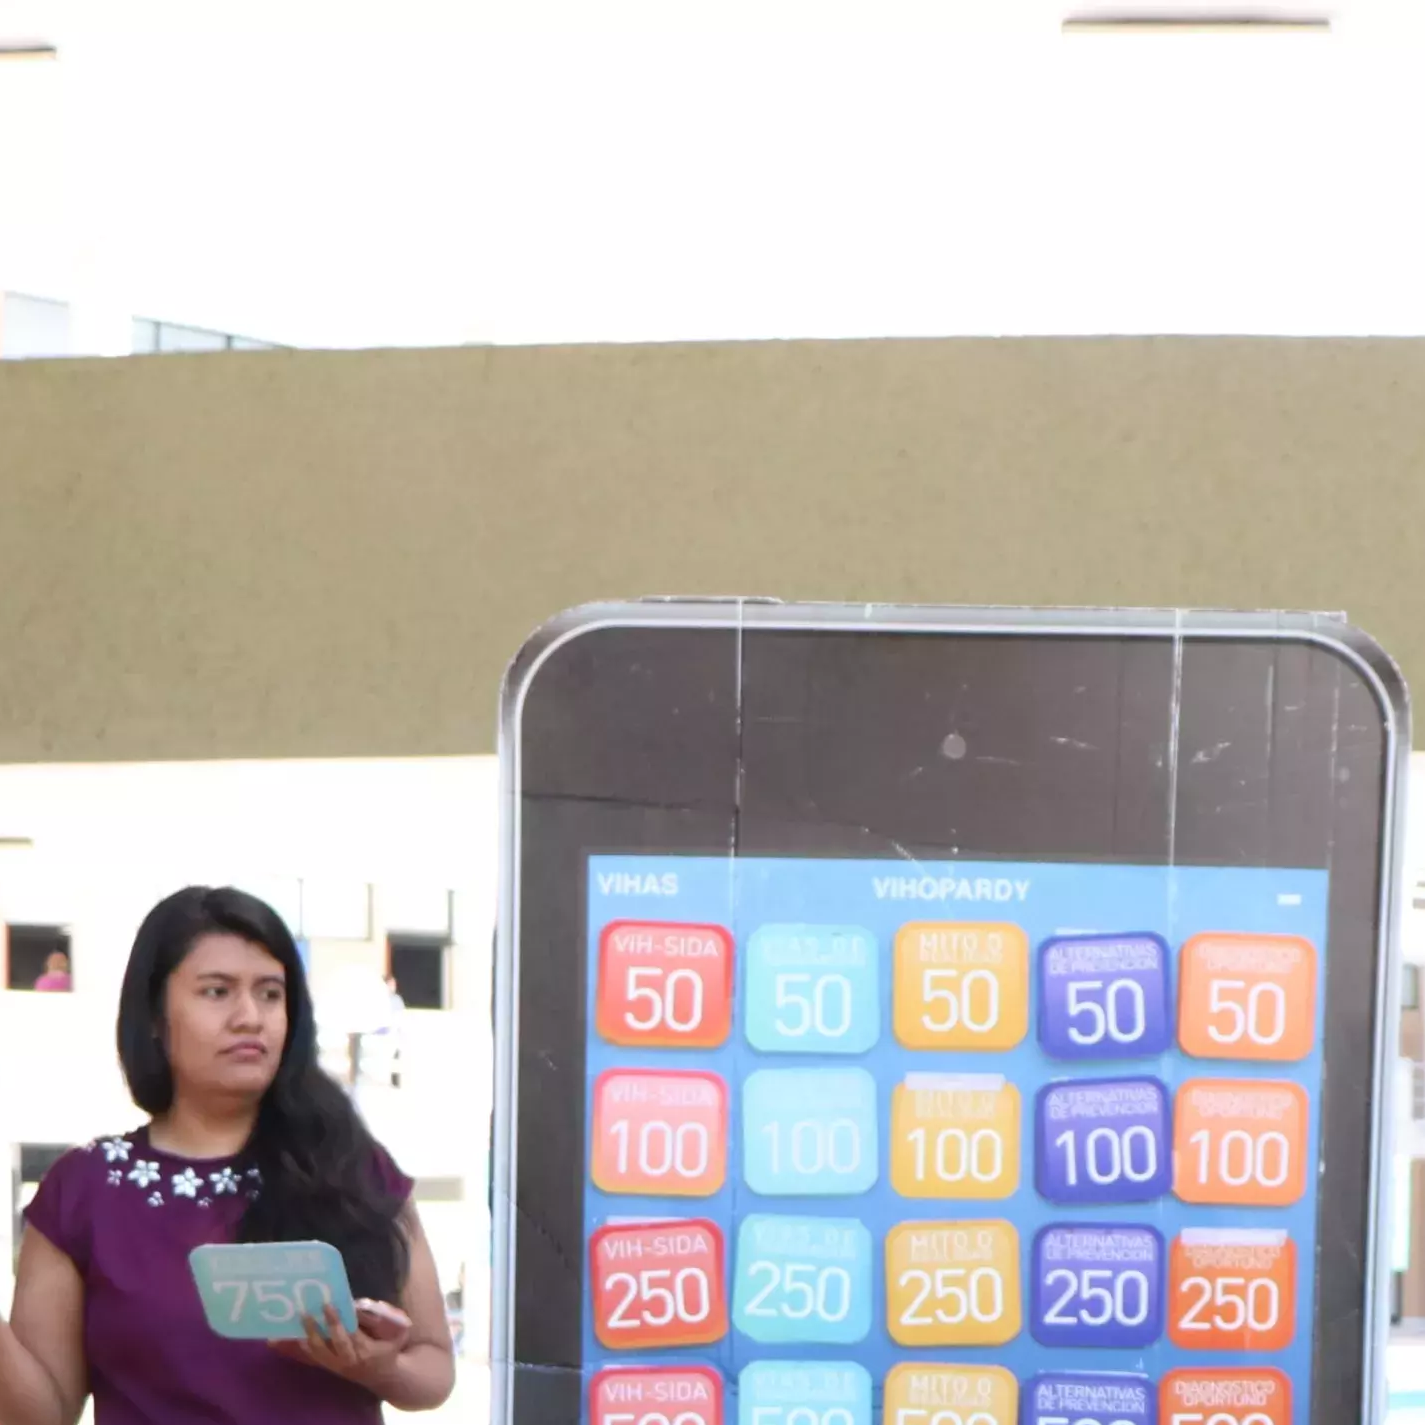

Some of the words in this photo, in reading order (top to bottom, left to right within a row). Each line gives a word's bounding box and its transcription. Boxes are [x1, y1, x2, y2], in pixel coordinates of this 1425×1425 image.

[598, 873, 679, 897] VIHAS
[873, 877, 1032, 901] VIHOPARDY
[613, 933, 719, 959] VIH-SIDA
[624, 966, 703, 1032] 50
[774, 973, 852, 1037] 50
[920, 969, 1000, 1033] 50
[1067, 980, 1145, 1045] 50
[1207, 979, 1285, 1045] 50
[610, 1082, 714, 1107] VIH-SIDA
[609, 1119, 708, 1178] 100
[761, 1118, 860, 1174] 100
[906, 1128, 1003, 1182] 100
[1055, 1126, 1156, 1186] 100
[1188, 1129, 1289, 1187] 100
[603, 1233, 708, 1261] VIH-SIDA
[1044, 1234, 1153, 1249] ALTERNATIVAS
[1046, 1248, 1066, 1261] DE
[212, 1278, 332, 1325] 750
[604, 1267, 711, 1330] 250
[744, 1260, 850, 1323] 250
[898, 1267, 1004, 1325] 250
[1043, 1269, 1149, 1327] 250
[1177, 1277, 1278, 1331] 250
[603, 1381, 709, 1403] VIH-SIDA
[910, 1374, 968, 1393] MITO
[1038, 1384, 1145, 1400] ALTERNATIVAS
[1038, 1398, 1055, 1410] DE
